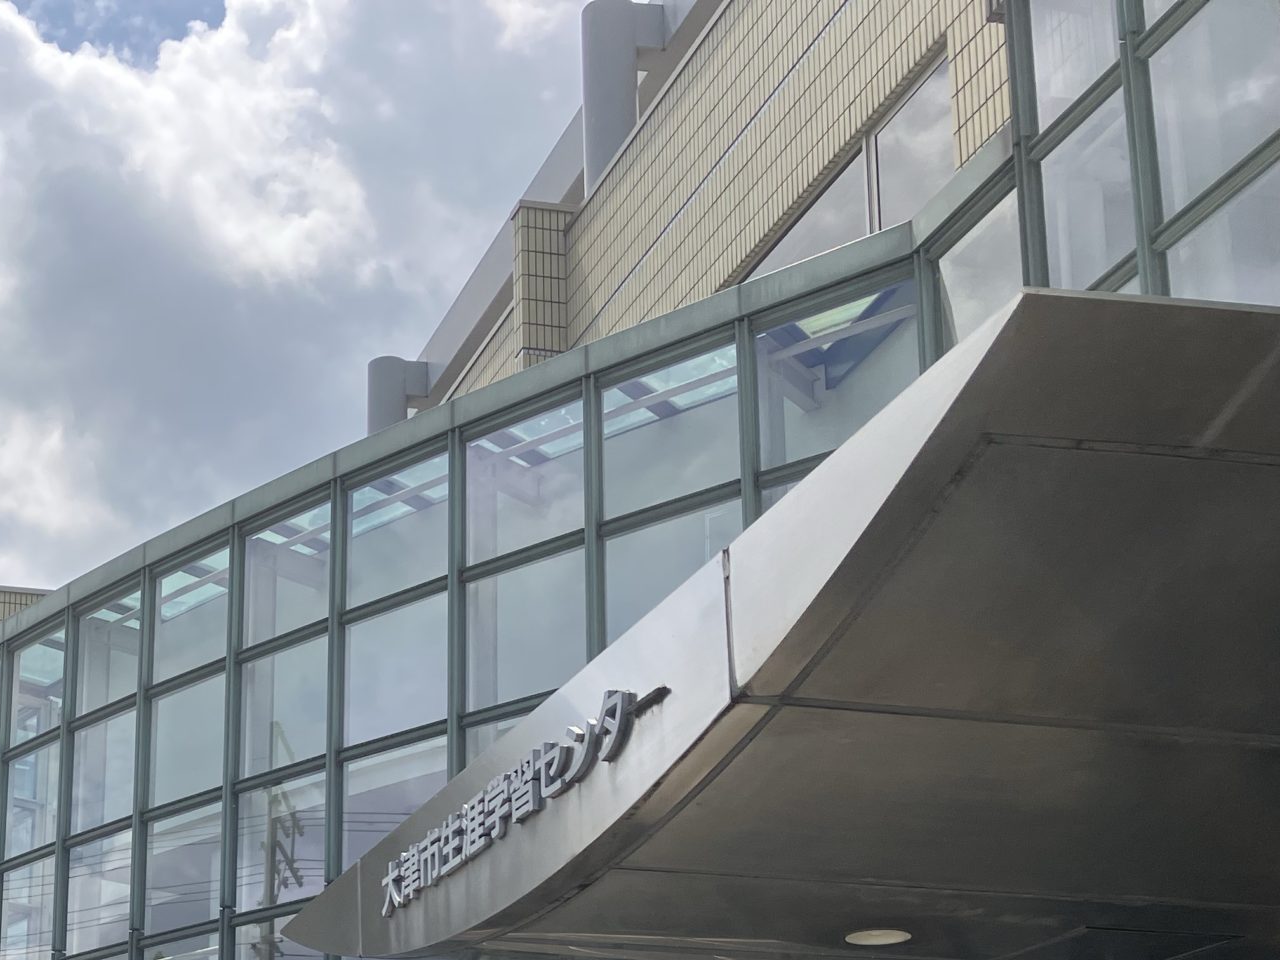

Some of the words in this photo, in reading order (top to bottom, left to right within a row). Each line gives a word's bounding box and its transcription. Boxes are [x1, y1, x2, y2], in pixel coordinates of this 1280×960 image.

[380, 684, 673, 917] 大津市生涯学習センター
